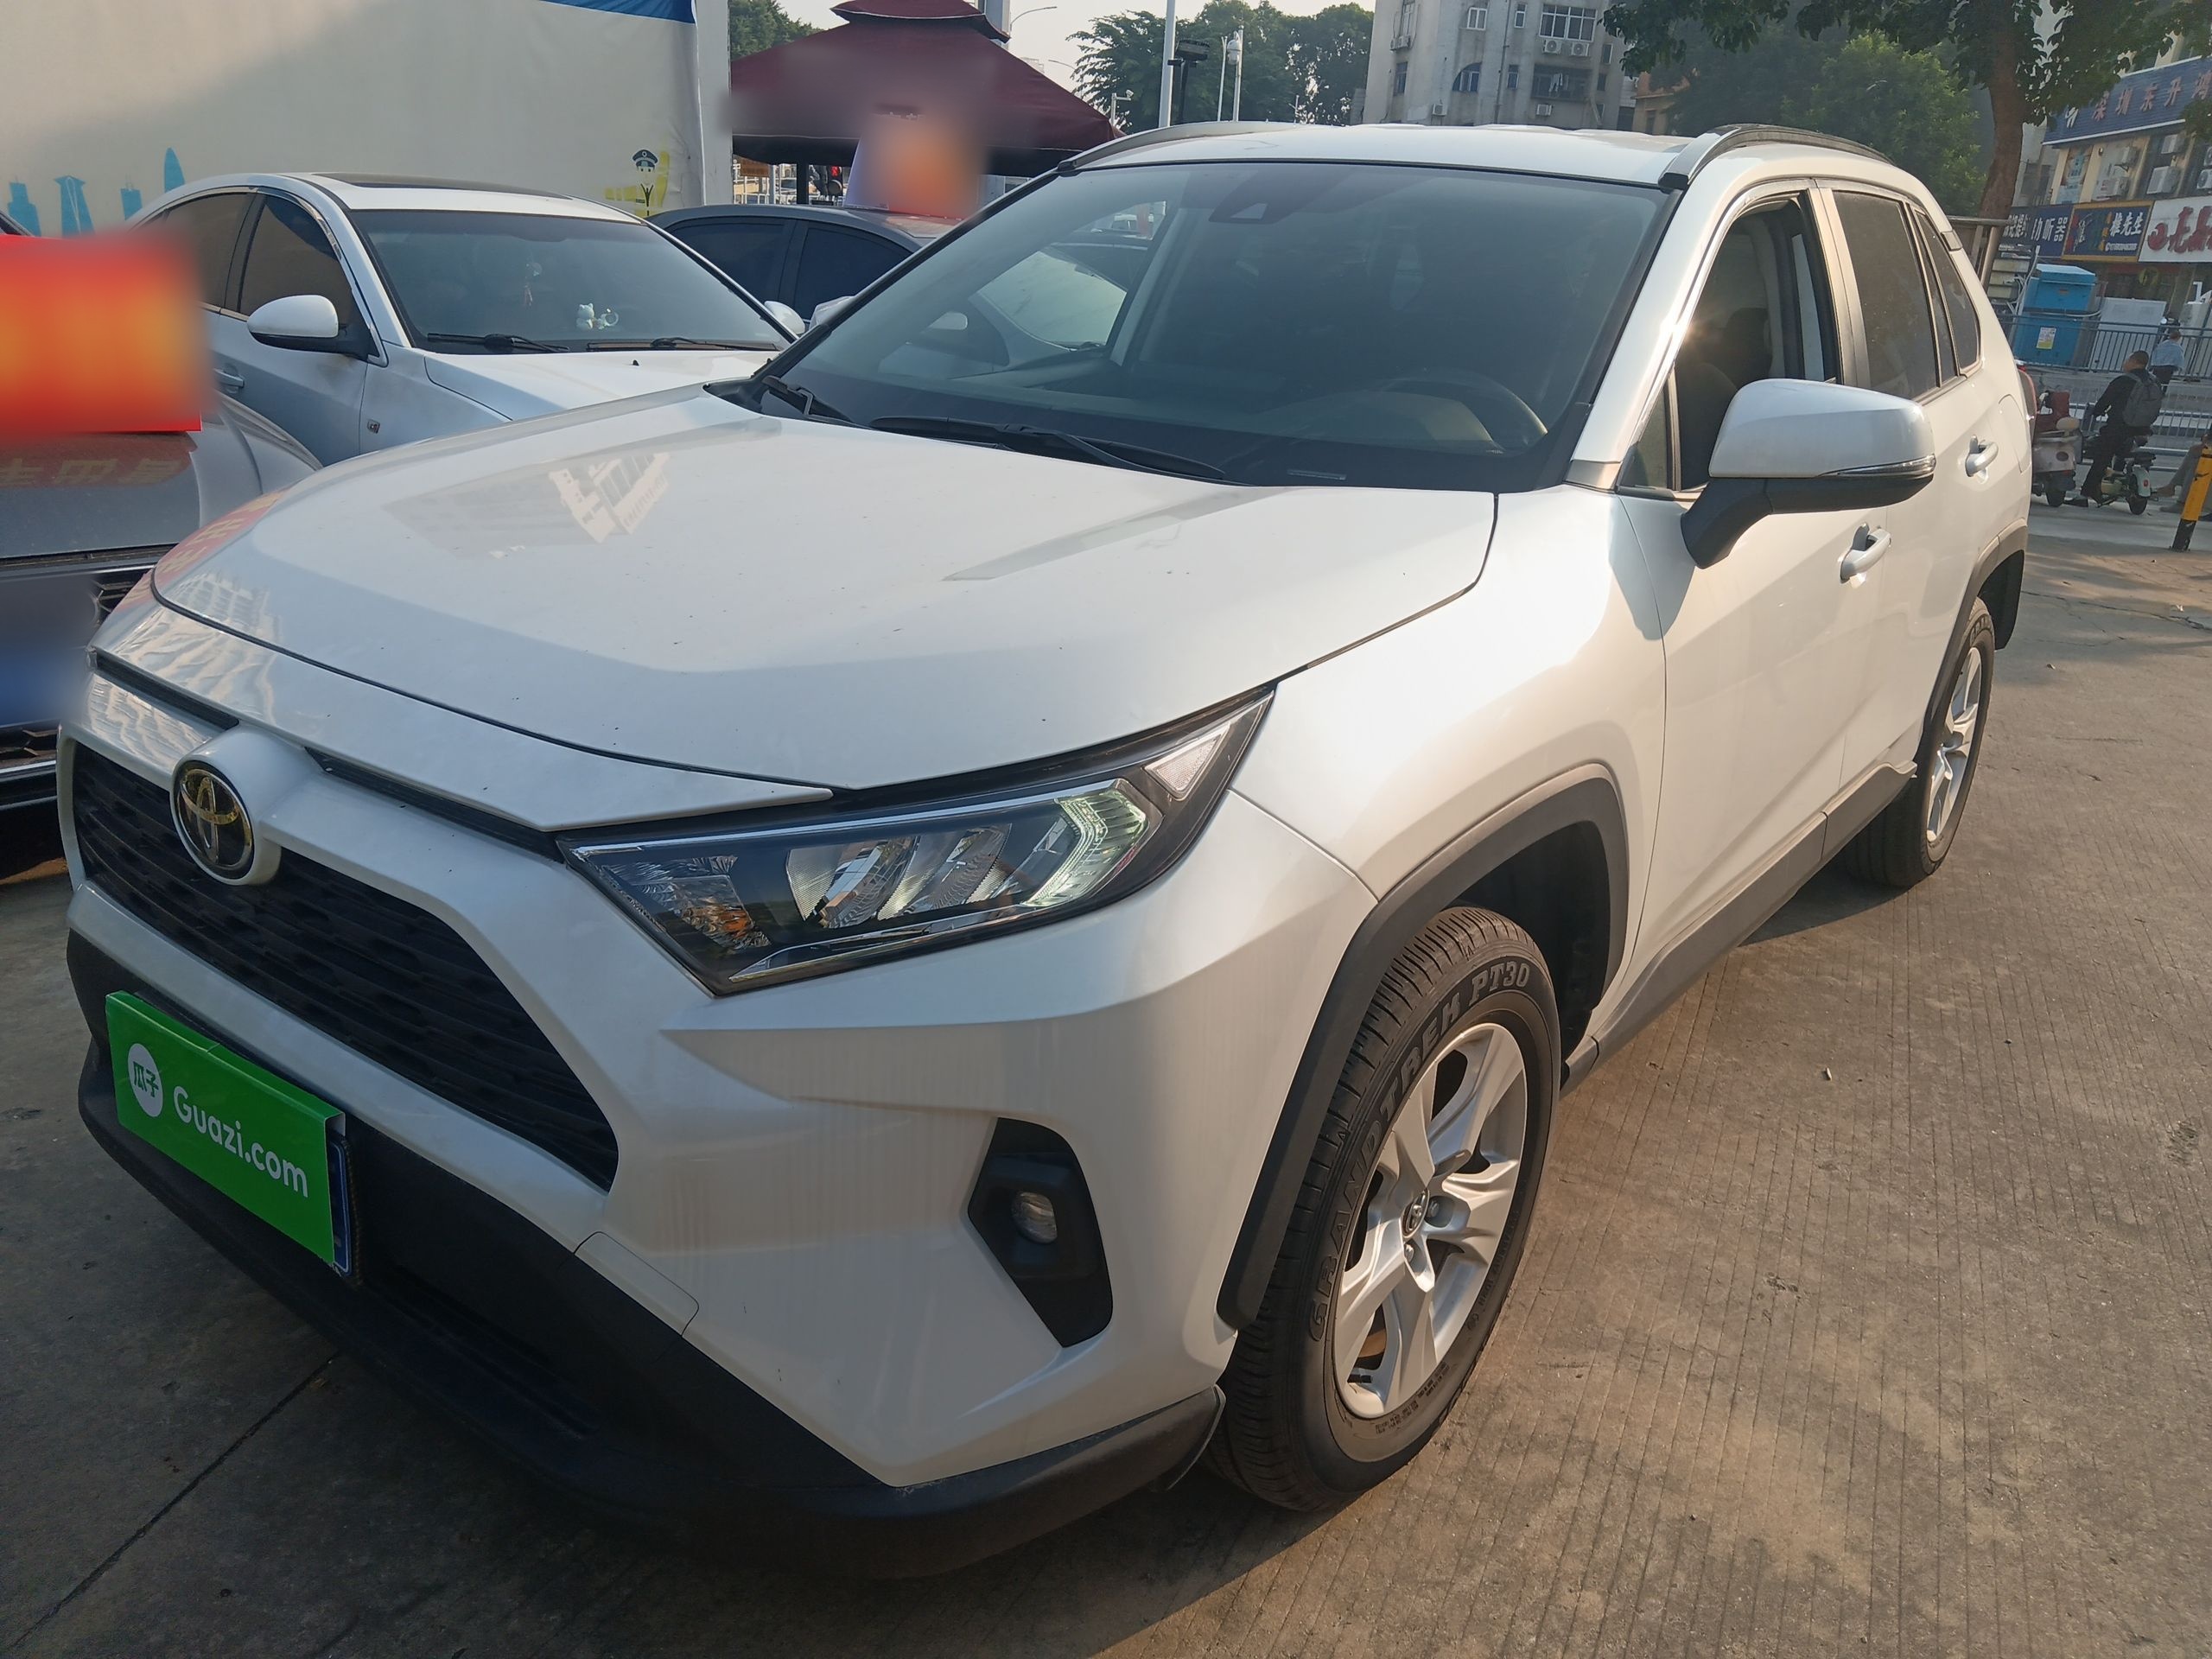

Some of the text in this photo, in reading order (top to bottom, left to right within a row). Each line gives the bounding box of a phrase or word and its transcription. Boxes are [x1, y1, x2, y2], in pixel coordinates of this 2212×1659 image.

[1469, 961, 1530, 1006] PT30
[132, 1060, 160, 1098] 瓜子
[174, 1085, 308, 1198] Guazi.com
